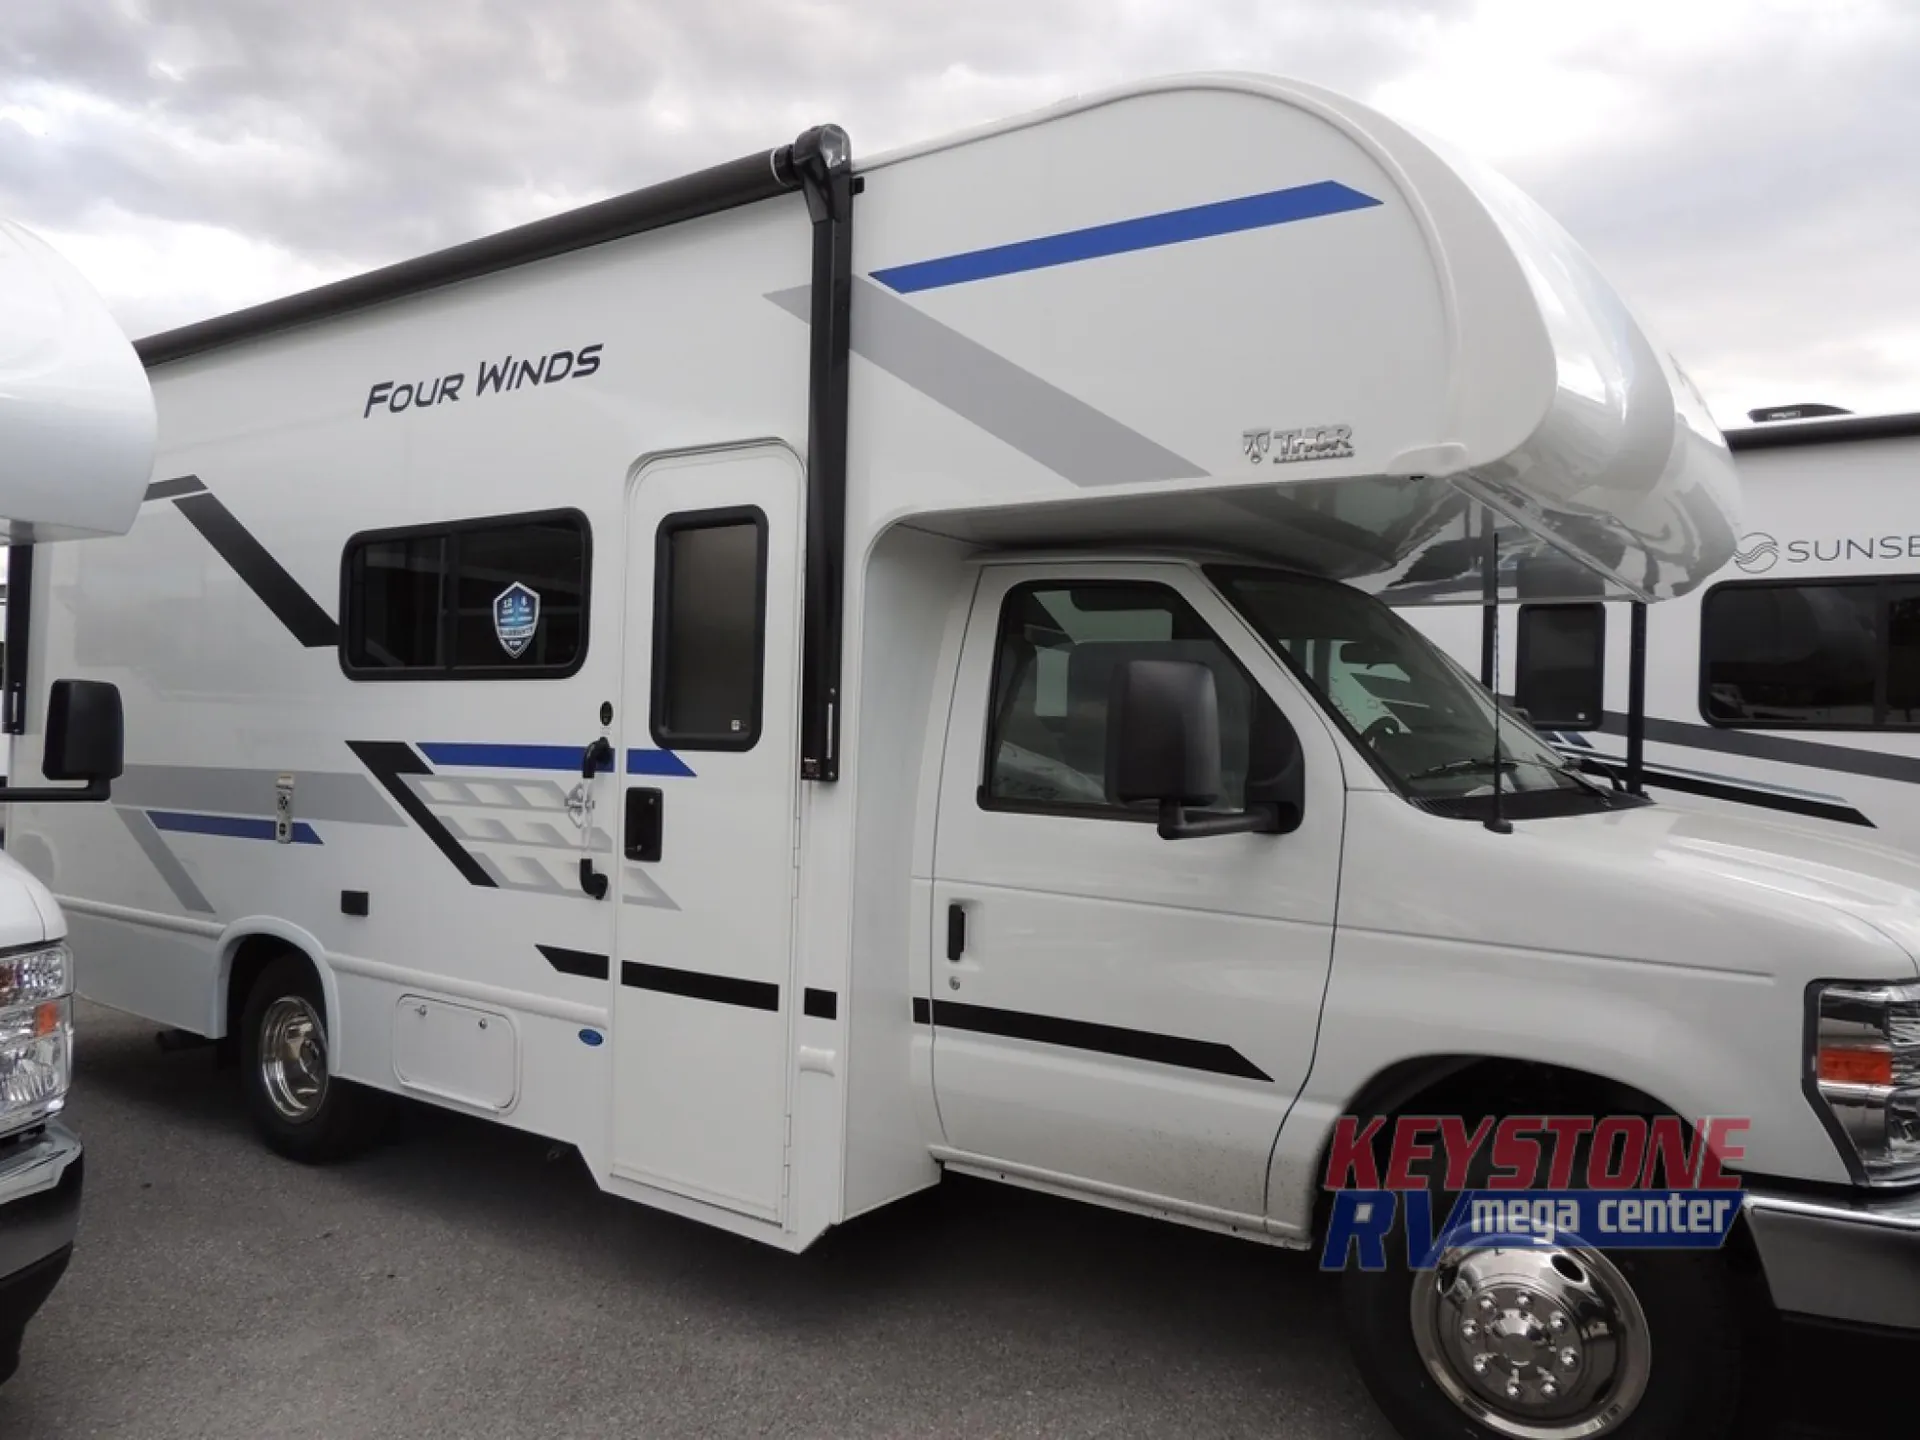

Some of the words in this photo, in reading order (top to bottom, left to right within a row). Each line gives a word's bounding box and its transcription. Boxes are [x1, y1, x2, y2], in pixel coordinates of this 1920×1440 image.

[363, 373, 465, 419] FOUR
[475, 343, 604, 397] WINDS
[1273, 425, 1353, 455] THOR
